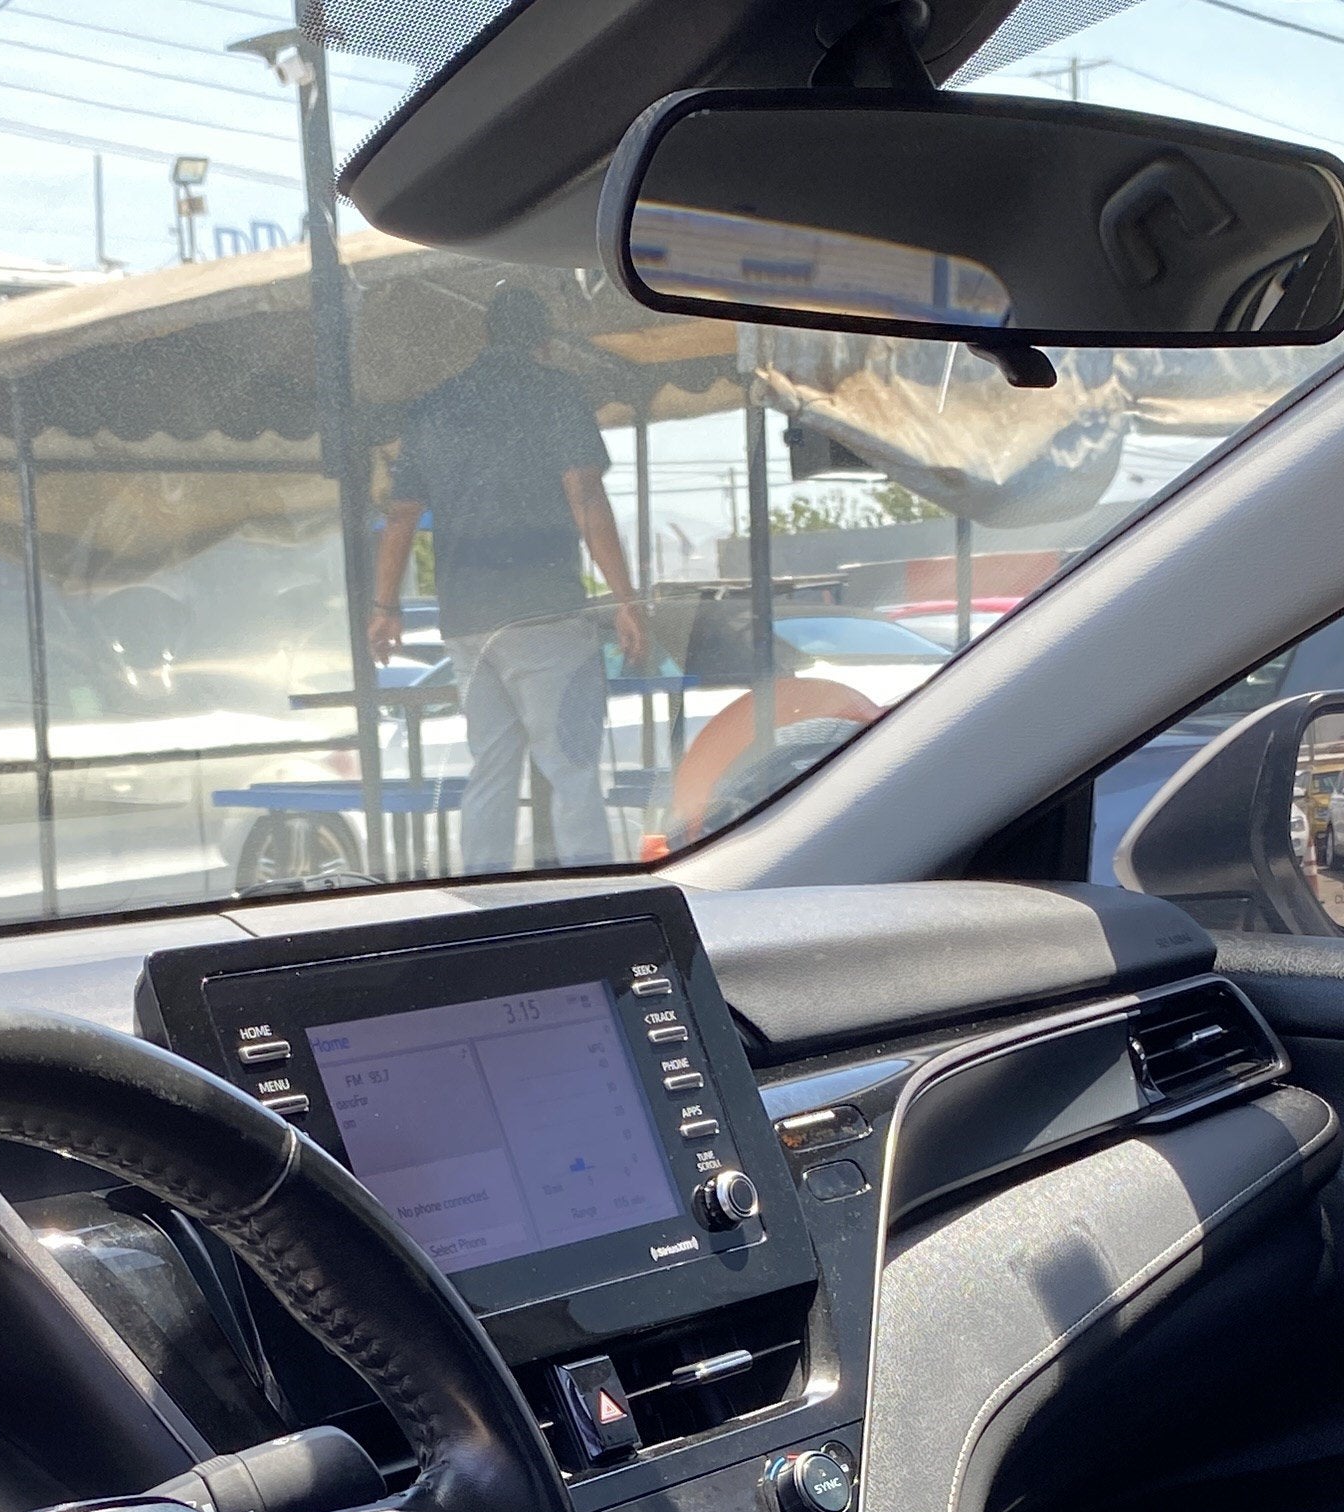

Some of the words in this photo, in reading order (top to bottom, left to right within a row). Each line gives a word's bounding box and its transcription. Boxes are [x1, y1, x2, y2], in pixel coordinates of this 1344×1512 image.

[649, 1010, 677, 1024] TRACK
[239, 1024, 272, 1040] HOME
[661, 1057, 690, 1072] PHONE
[258, 1078, 290, 1094] MENU
[682, 1105, 703, 1118] APPS
[812, 1477, 843, 1496] SYNC
